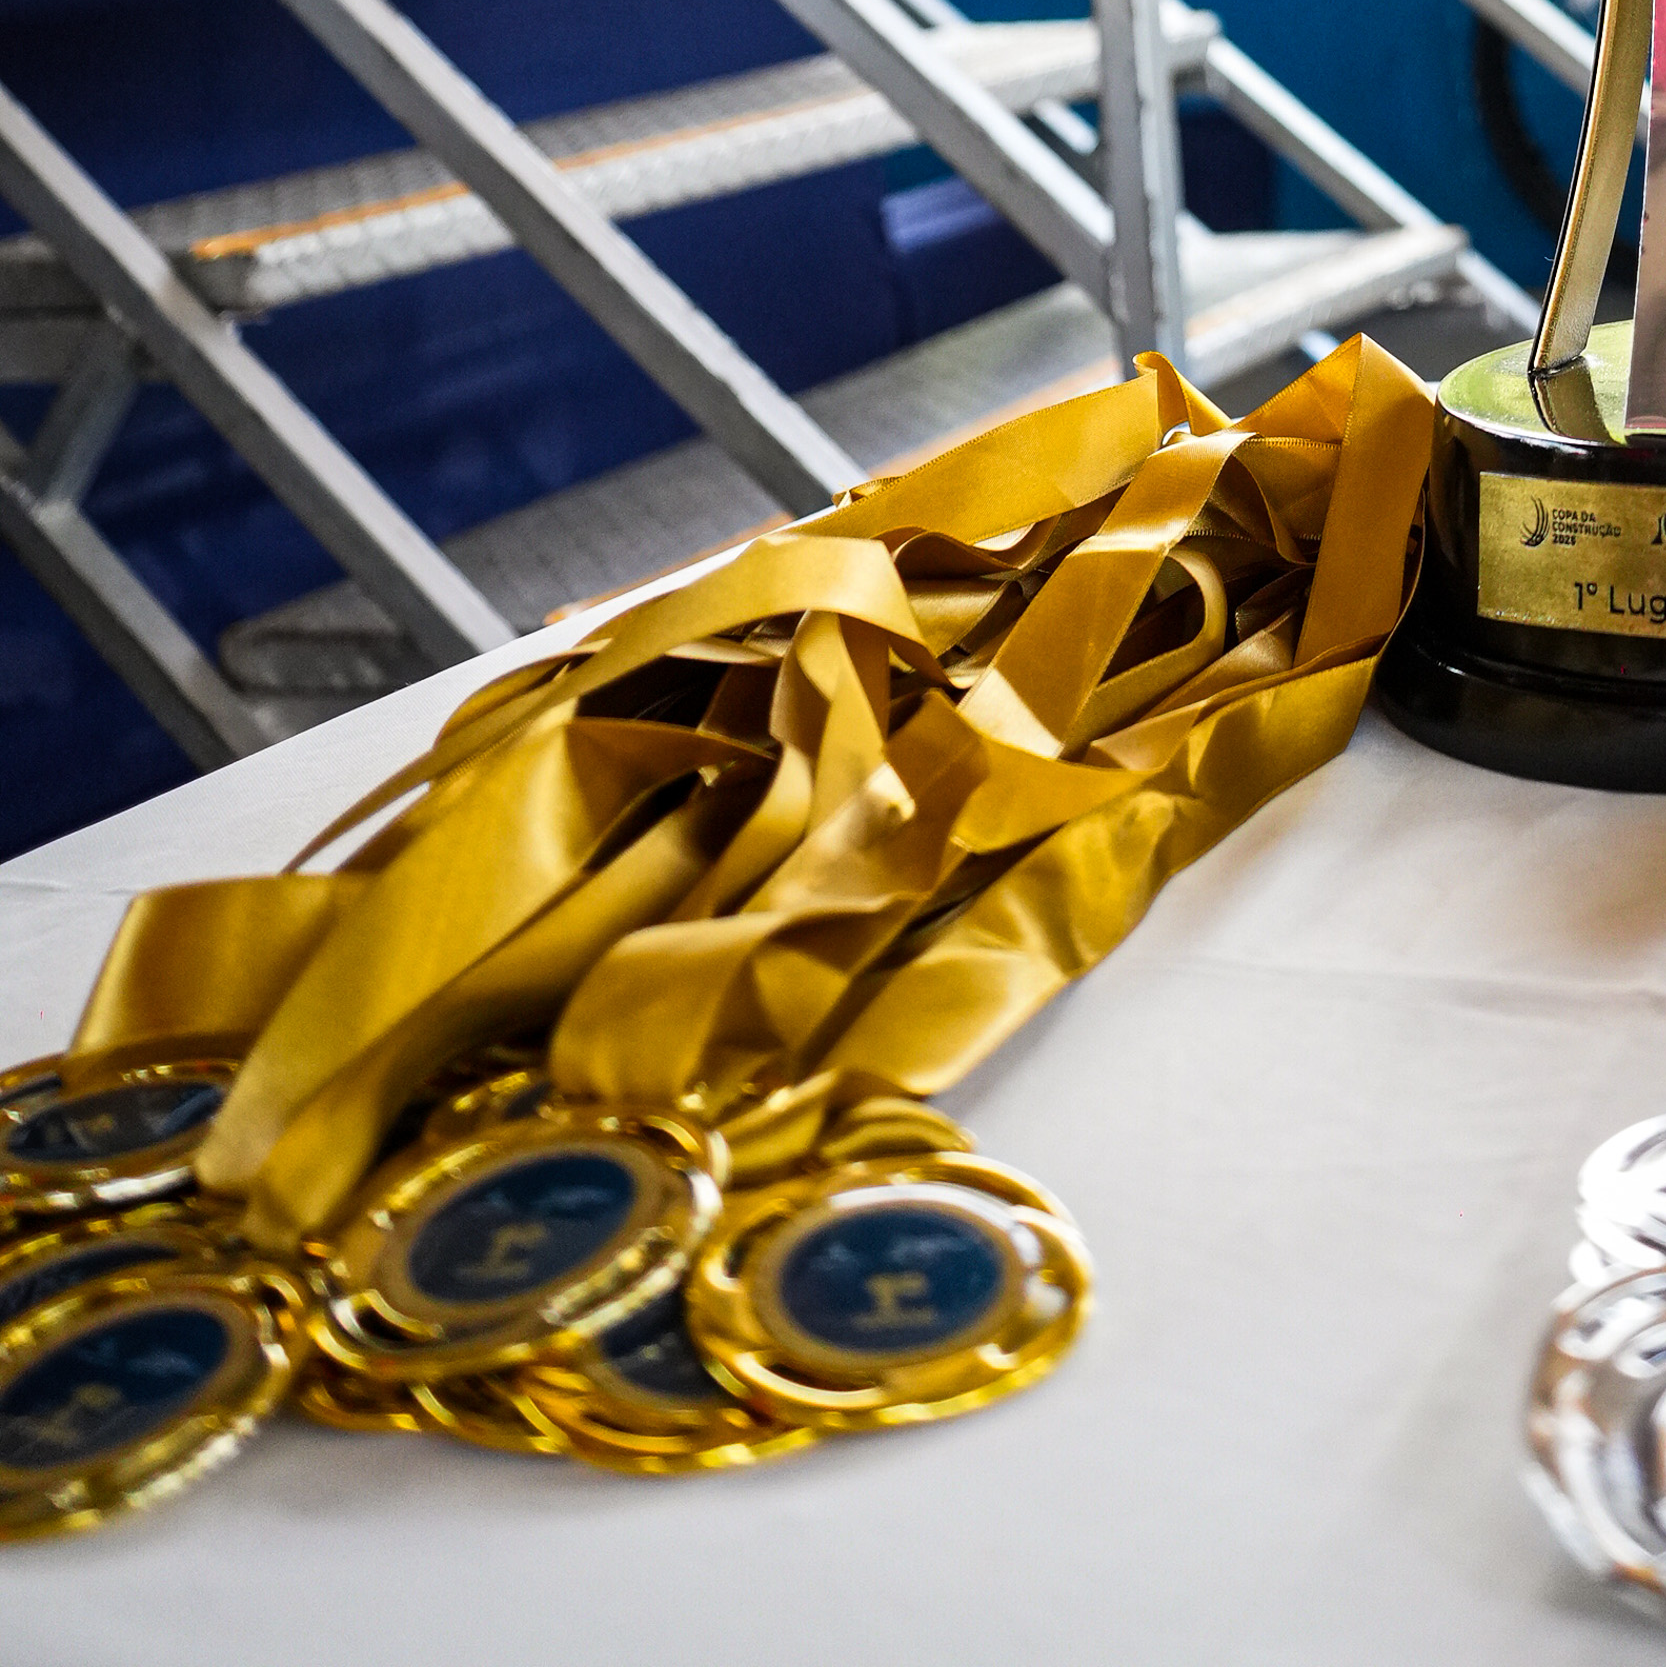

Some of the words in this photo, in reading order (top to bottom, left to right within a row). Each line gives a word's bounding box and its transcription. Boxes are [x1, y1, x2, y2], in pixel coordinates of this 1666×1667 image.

[1552, 508, 1578, 521] COPA
[1581, 510, 1596, 523] DA
[1552, 521, 1622, 538] CONSTRUÇÃO
[1574, 582, 1598, 611] 1º
